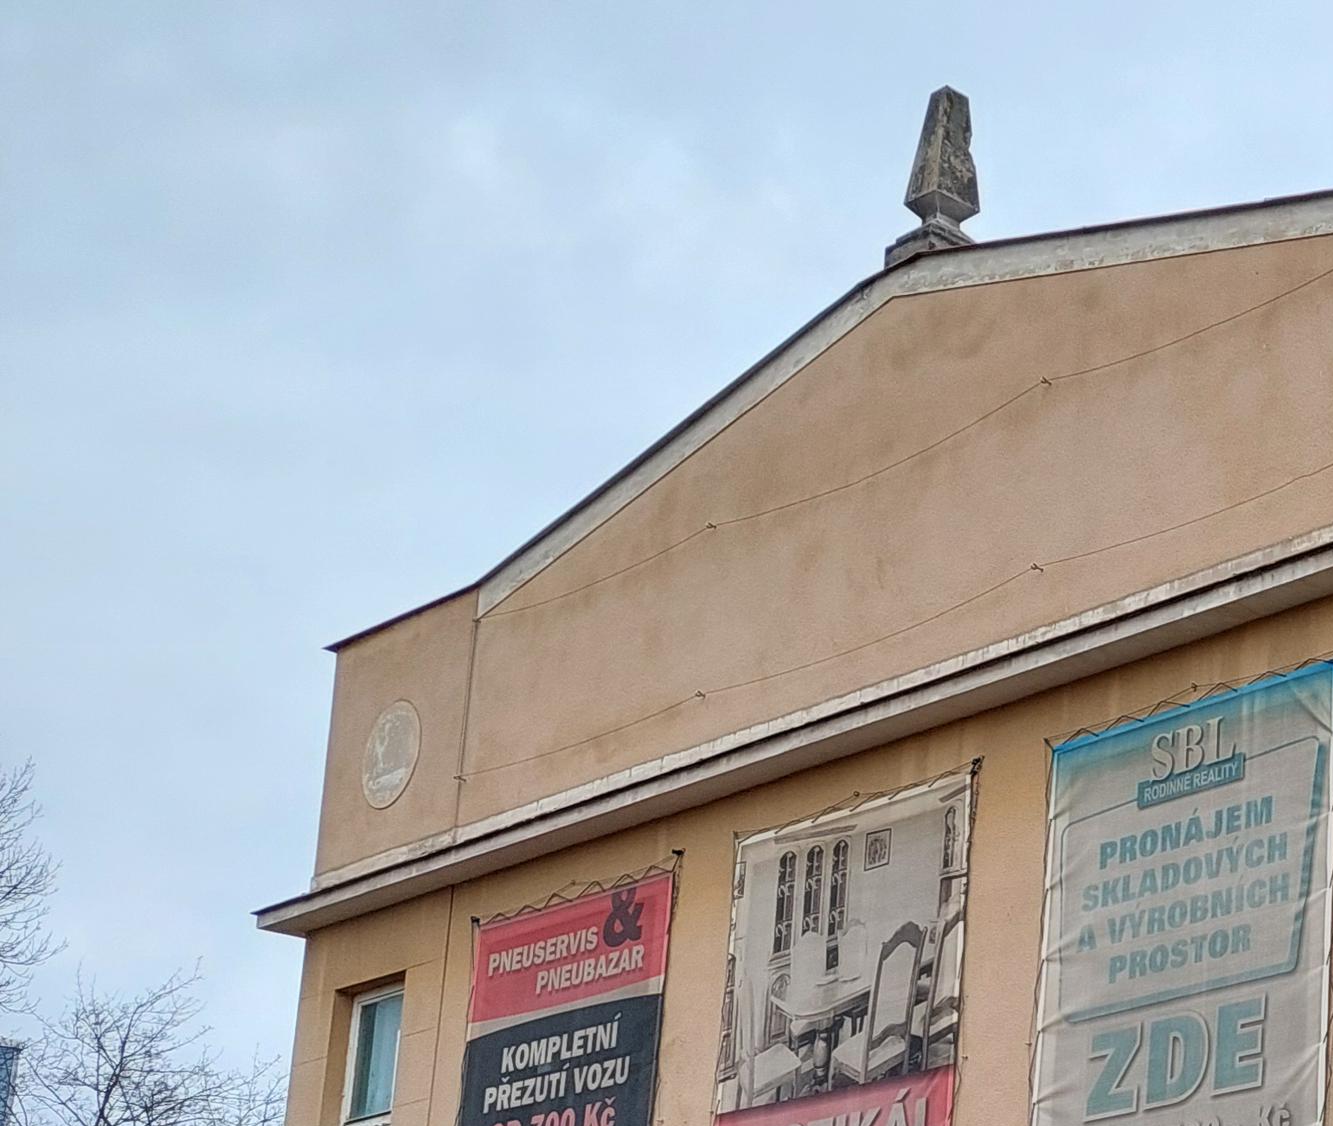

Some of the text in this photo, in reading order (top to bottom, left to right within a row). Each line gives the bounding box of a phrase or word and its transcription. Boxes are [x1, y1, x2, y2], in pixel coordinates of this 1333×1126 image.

[1152, 715, 1237, 781] SBL
[1193, 762, 1239, 788] REALITY
[1099, 796, 1274, 870] PRONÁJEM
[1081, 832, 1288, 912] SKLADOVÝCH
[488, 887, 645, 977] PNEUSERVIS &
[1077, 873, 1290, 952] A VÝROBNÍCH
[535, 944, 644, 995] PNEUBAZAR
[1108, 923, 1251, 984] PROSTOR
[501, 1012, 622, 1073] KOMPLETNÍ
[1083, 992, 1268, 1124] ZDE
[482, 1056, 631, 1114] PŘEZUTÍ VOZU
